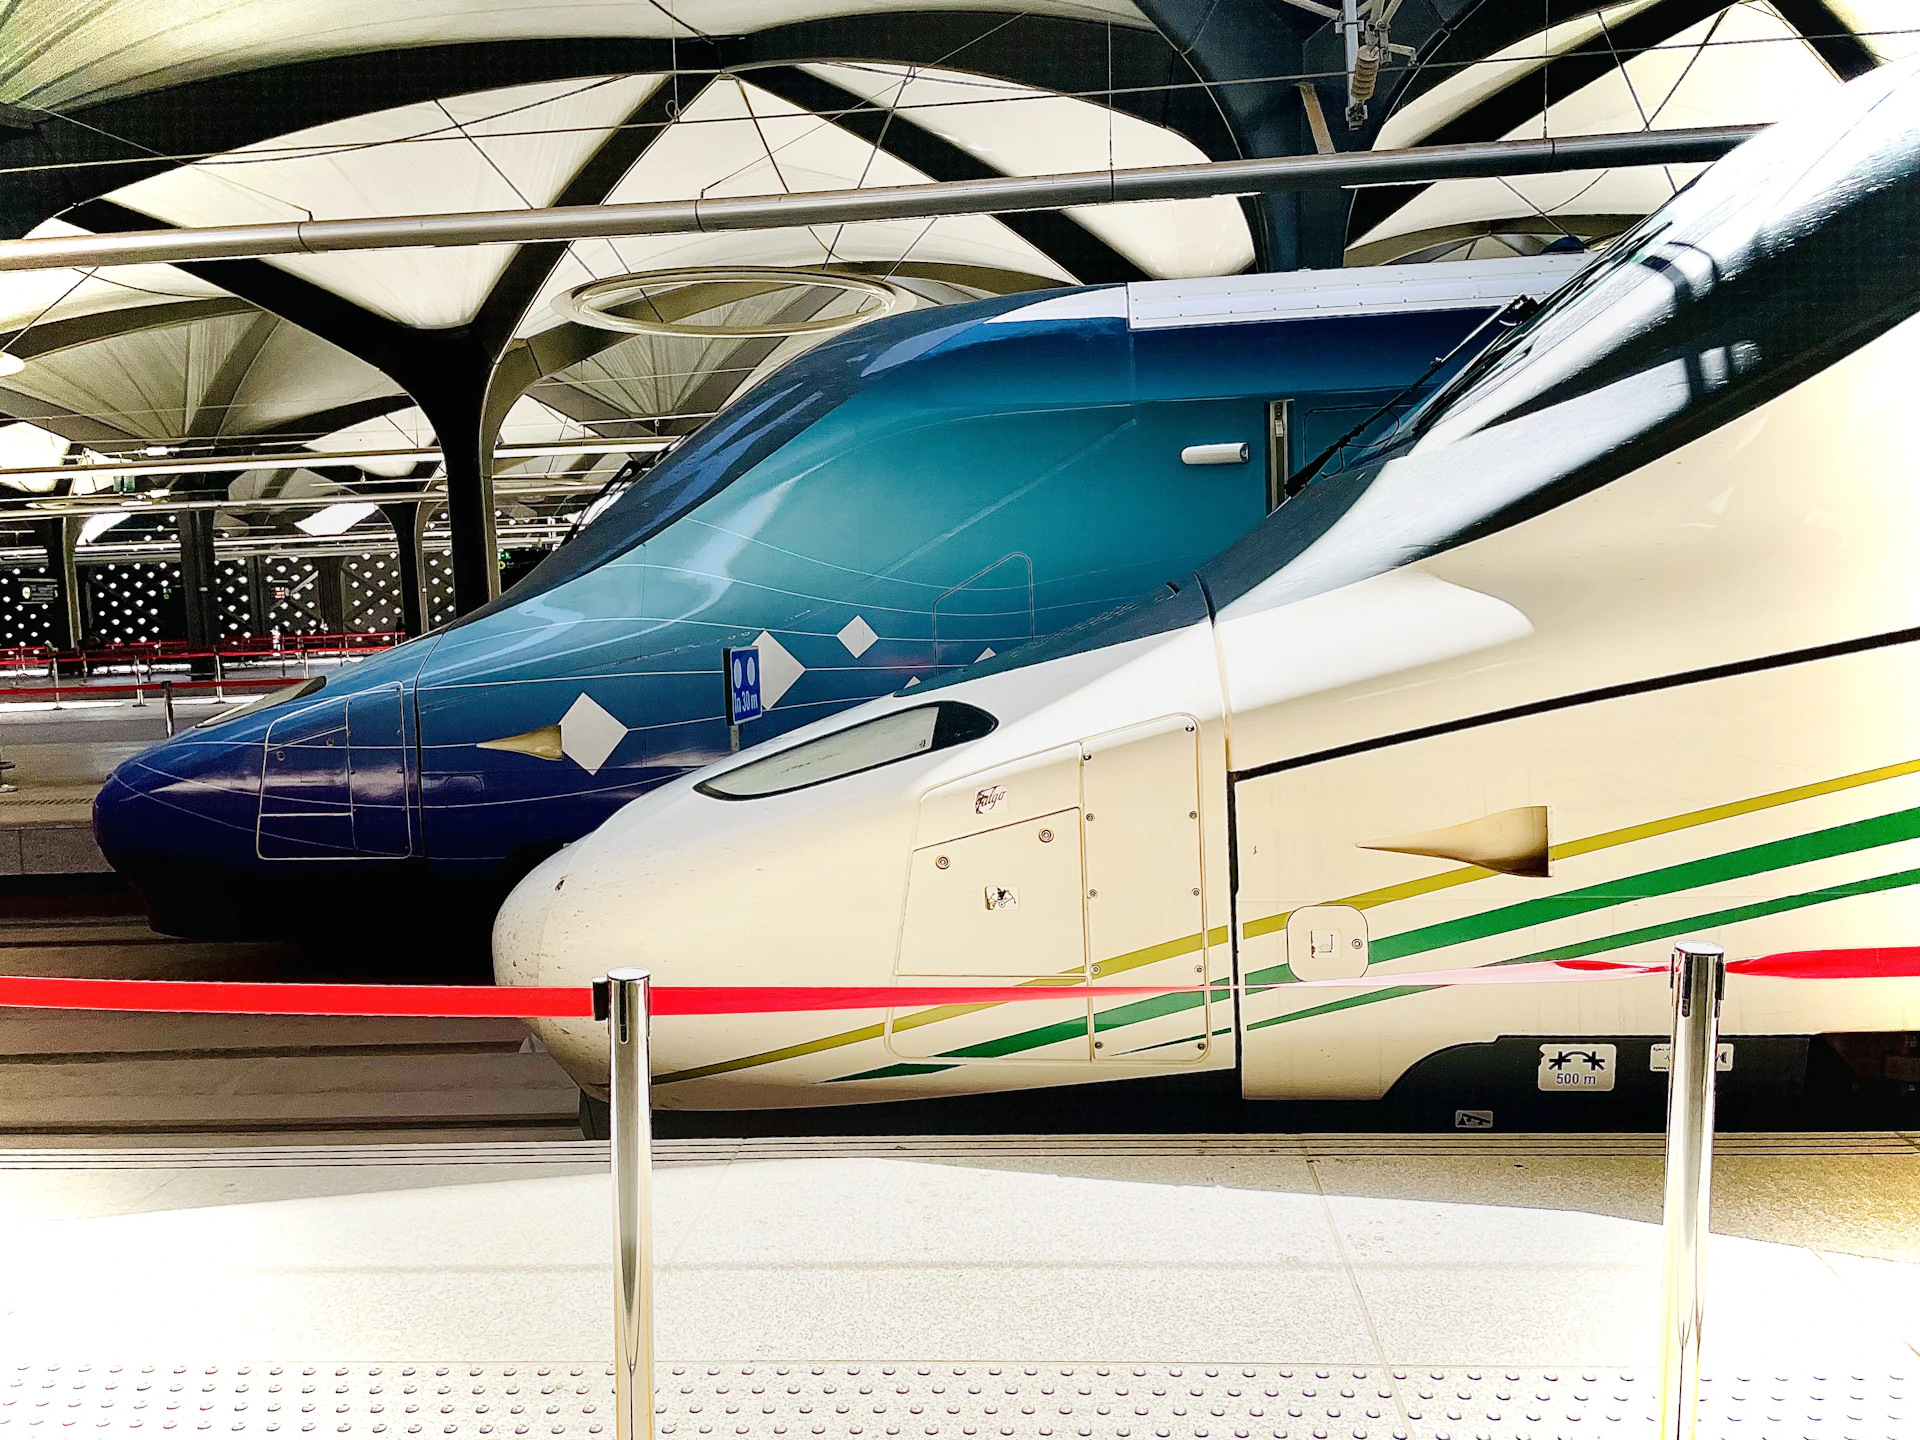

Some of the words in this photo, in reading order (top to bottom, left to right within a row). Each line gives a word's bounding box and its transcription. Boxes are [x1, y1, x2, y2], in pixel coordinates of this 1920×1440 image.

[742, 690, 751, 712] 30
[751, 693, 758, 709] m
[1556, 1072, 1580, 1085] 500
[1583, 1075, 1596, 1085] m
